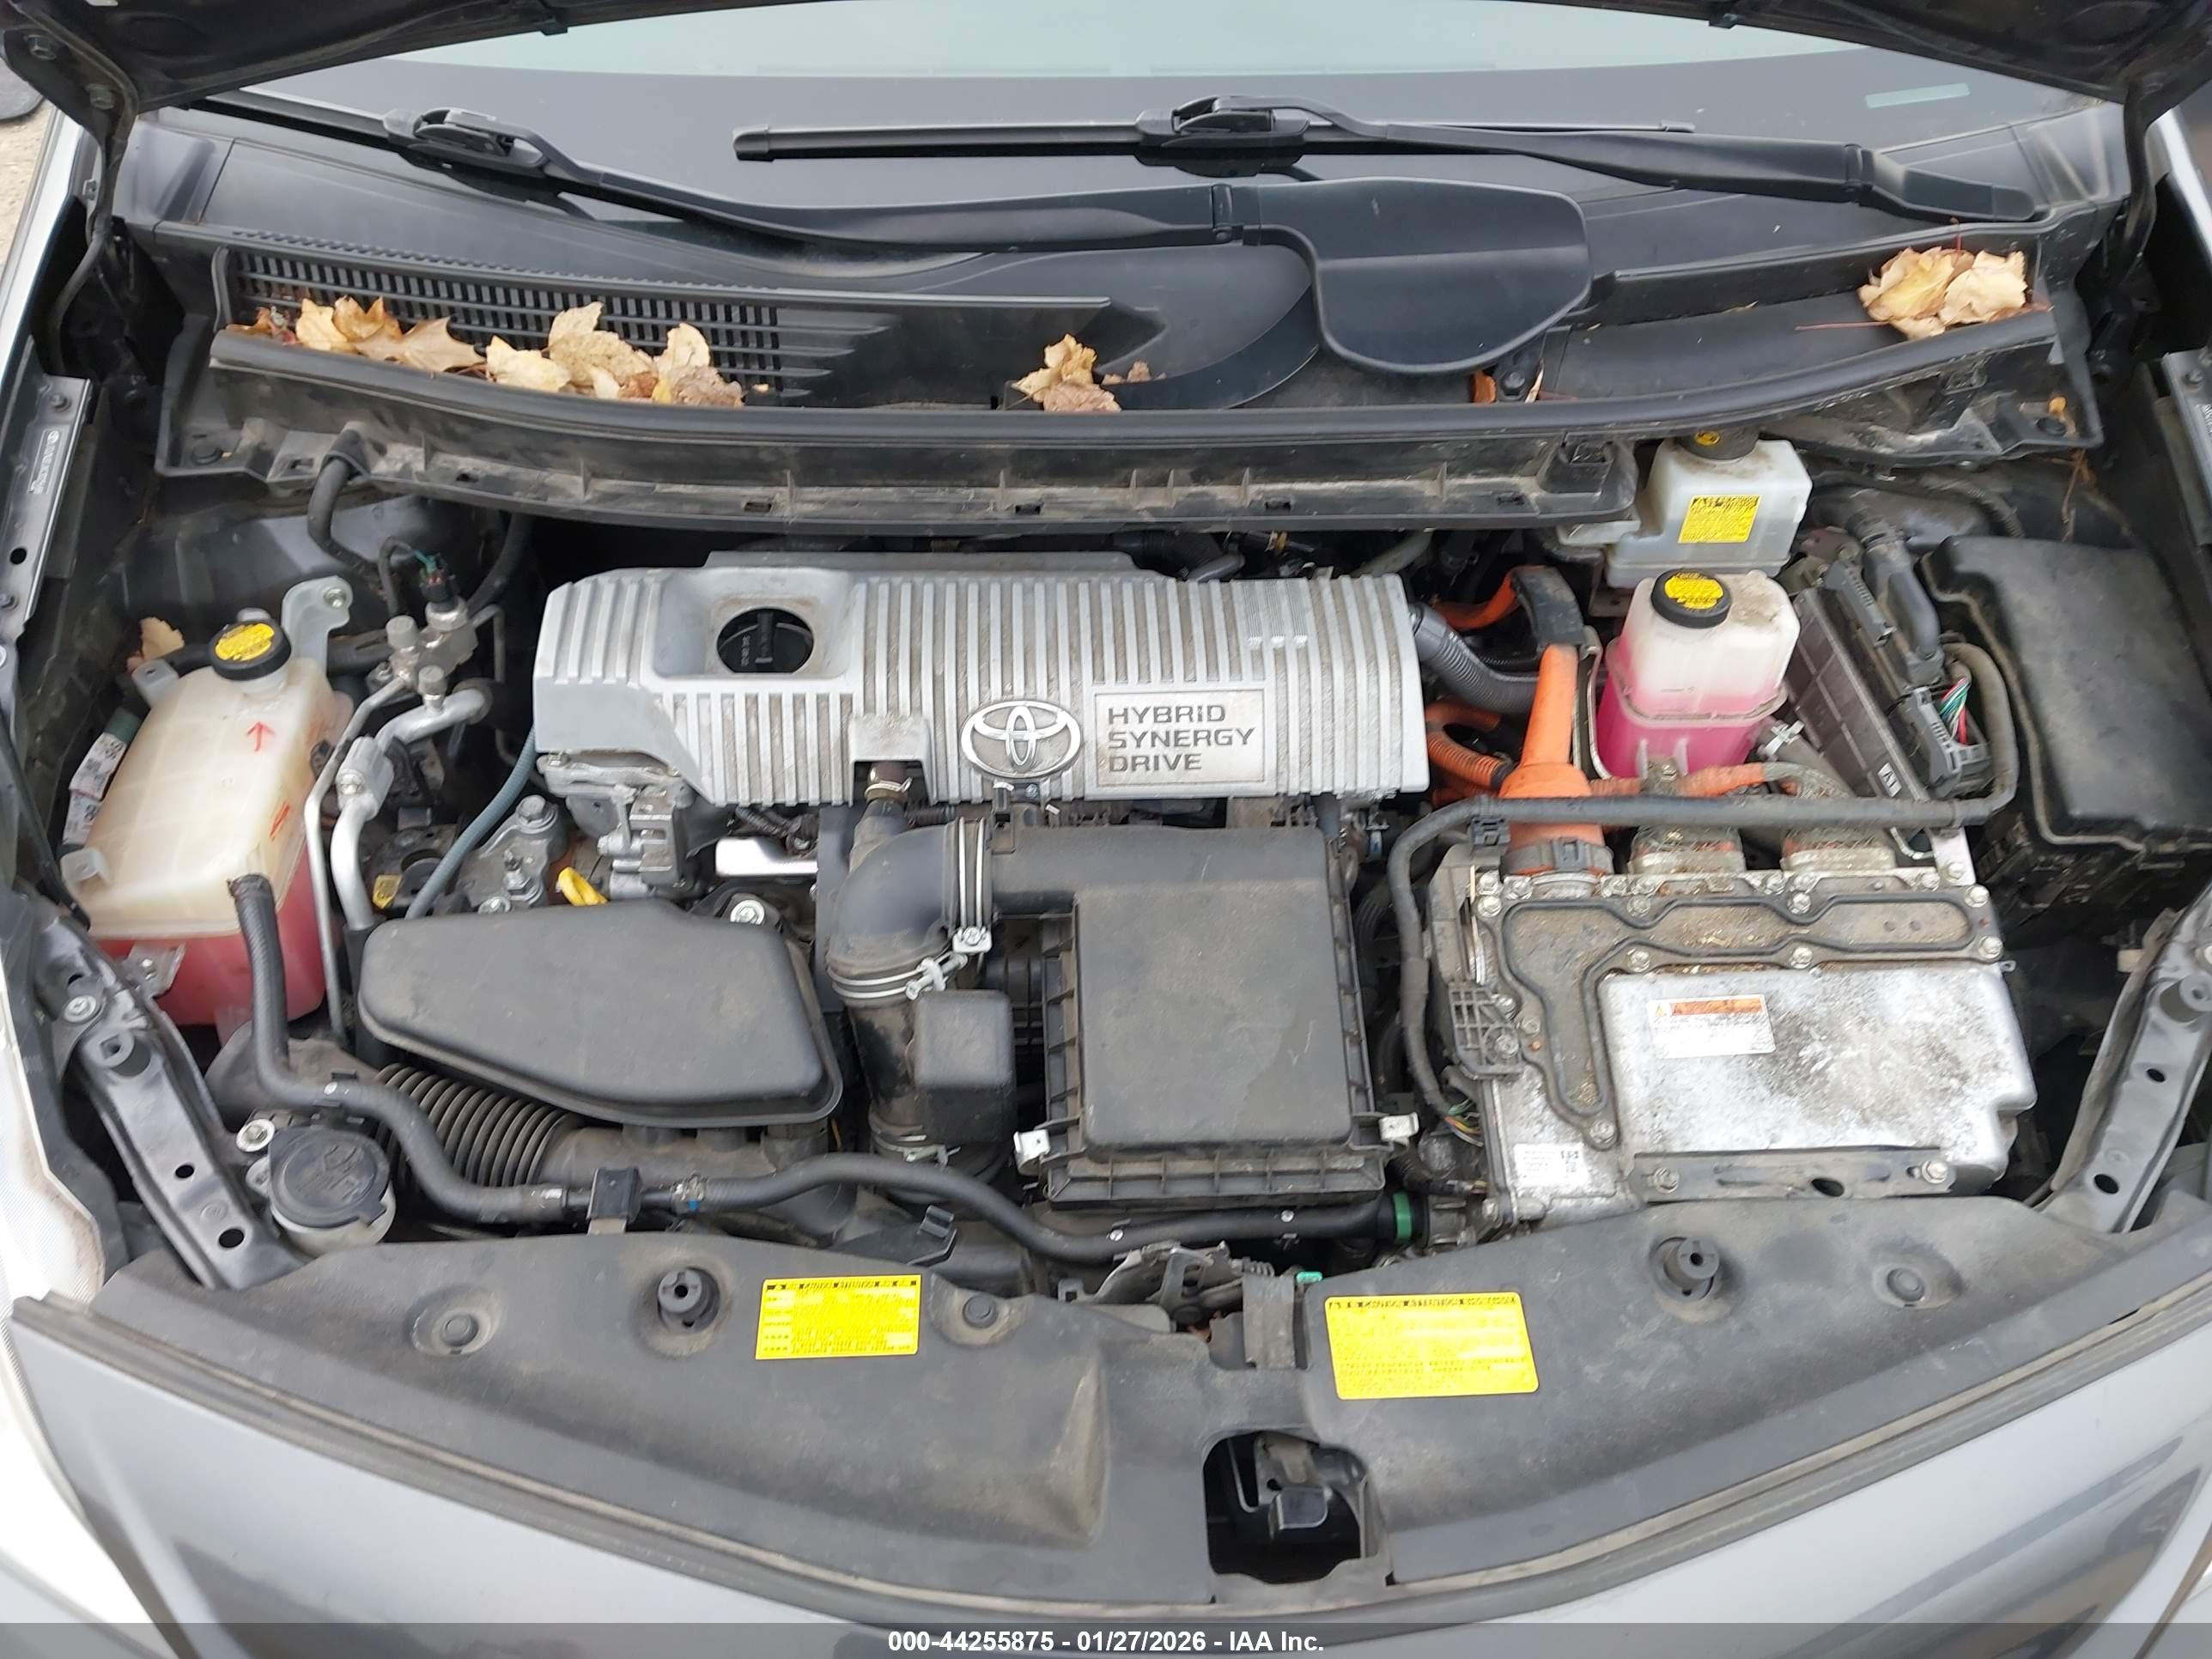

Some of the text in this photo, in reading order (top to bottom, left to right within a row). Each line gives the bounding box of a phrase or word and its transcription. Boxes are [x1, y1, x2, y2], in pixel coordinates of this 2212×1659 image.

[1108, 705, 1226, 725] HYBRID
[1108, 727, 1255, 750] SYNERGY
[1109, 752, 1202, 773] DRIVE
